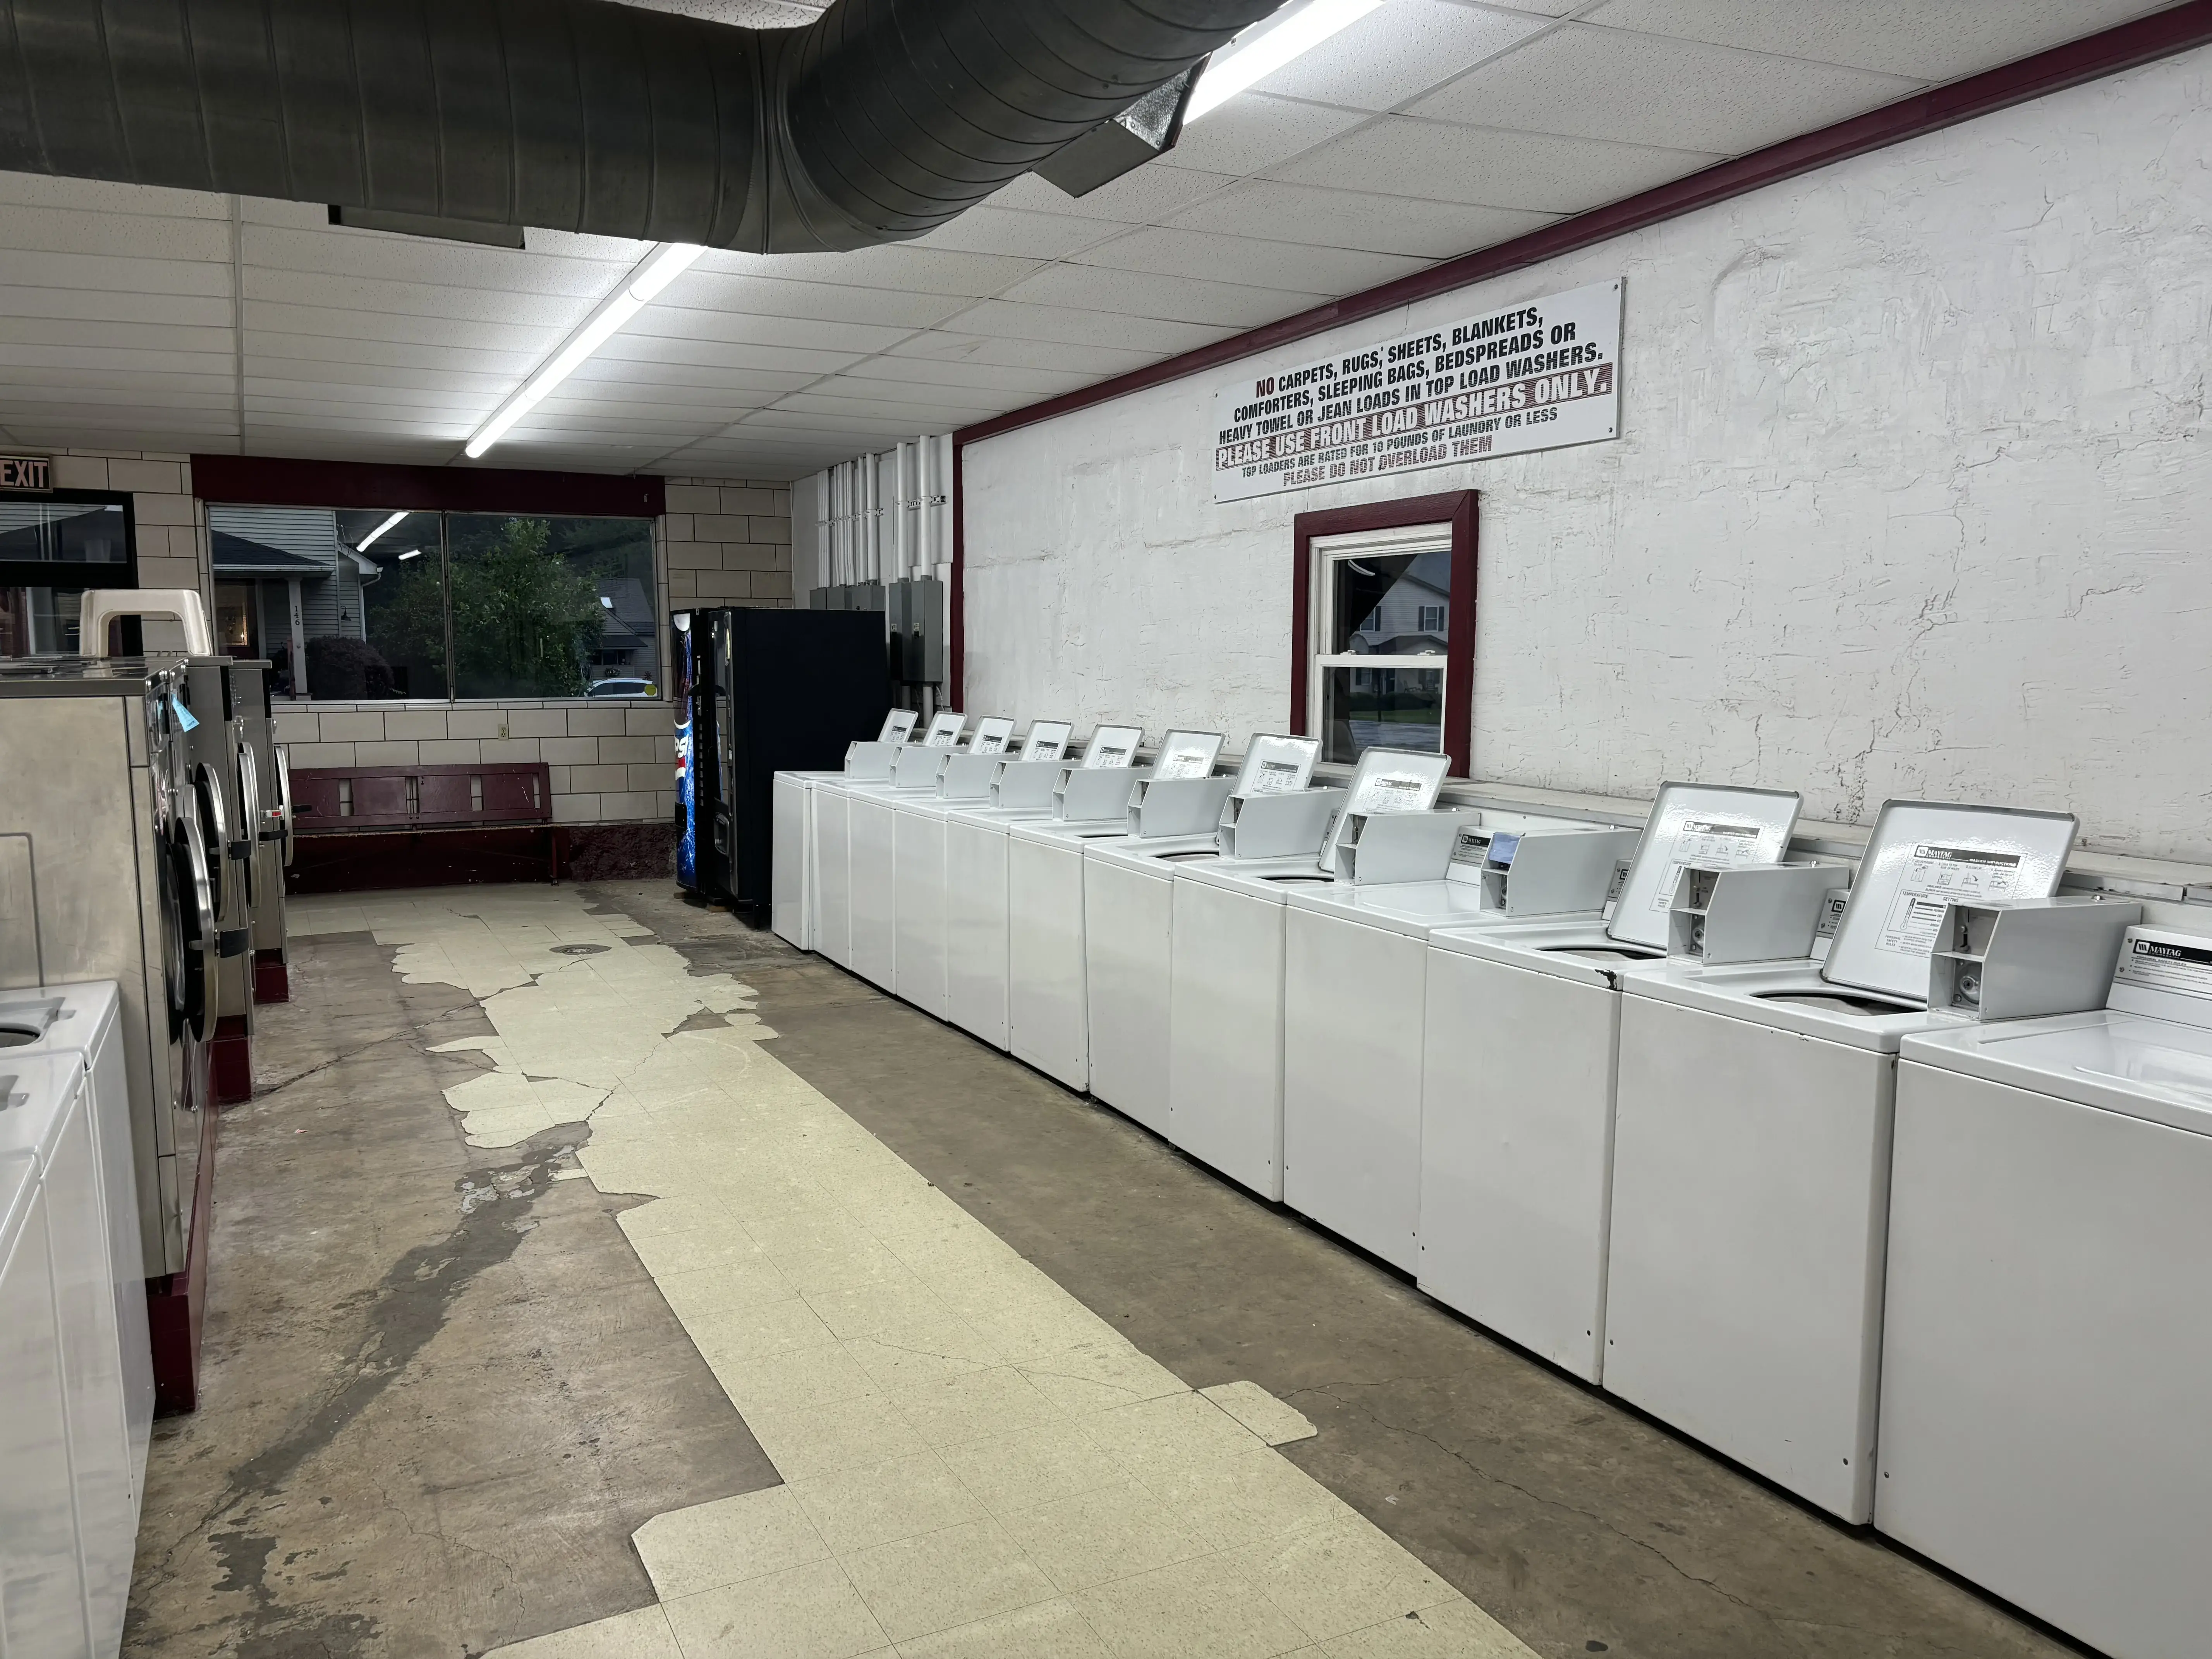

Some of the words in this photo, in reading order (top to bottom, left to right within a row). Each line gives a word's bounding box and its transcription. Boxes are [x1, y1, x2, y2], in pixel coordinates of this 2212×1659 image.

[1234, 390, 1313, 422] COMFORTERS,
[1318, 371, 1382, 402] SLEEPING
[1388, 360, 1429, 385] BAGS,
[1435, 330, 1543, 373] BEDSPREADS
[1551, 322, 1576, 345] OR
[1256, 377, 1274, 398] NO
[1279, 363, 1337, 392] CARPETS,
[1342, 351, 1382, 375] RUGS,
[1388, 333, 1446, 363] SHEETS,
[1452, 307, 1543, 346] BLANKETS,
[1219, 423, 1253, 445] HEAVY
[1256, 414, 1293, 436] TOWEL
[1297, 409, 1313, 426] OR
[1317, 399, 1352, 422] JEAN
[1357, 388, 1400, 413] LOADS
[1405, 383, 1421, 402] IN
[1426, 375, 1454, 397] TOP
[1460, 365, 1500, 390] LOAD
[1506, 342, 1603, 379] WASHERS.
[1219, 439, 1270, 467] PLEASE
[1275, 431, 1305, 456] USE
[1311, 418, 1366, 449] FRONT
[1372, 407, 1418, 436] LOAD
[1424, 383, 1526, 426] WASHERS
[1535, 368, 1607, 404] ONLY.
[0, 460, 47, 488] EXIT
[1242, 466, 1257, 478] TOP
[1259, 458, 1295, 475] LOADERS
[1298, 454, 1315, 467] ARE
[1318, 448, 1347, 464] RATED
[1350, 443, 1368, 457] FOR
[1372, 441, 1383, 453] 10
[1387, 431, 1428, 451] POUNDS
[1432, 428, 1445, 442] OF
[1448, 417, 1501, 439] LAUNDRY
[1505, 414, 1521, 429] OR
[1526, 407, 1558, 425] LESS
[1283, 465, 1325, 486] PLEASE
[1329, 462, 1346, 478] DO
[1350, 457, 1375, 475] NOT
[1379, 443, 1447, 470] OVERLOAD
[1452, 434, 1492, 457] THEM
[1926, 849, 1953, 858] MAYTAG
[2149, 946, 2182, 957] MAYTAG
